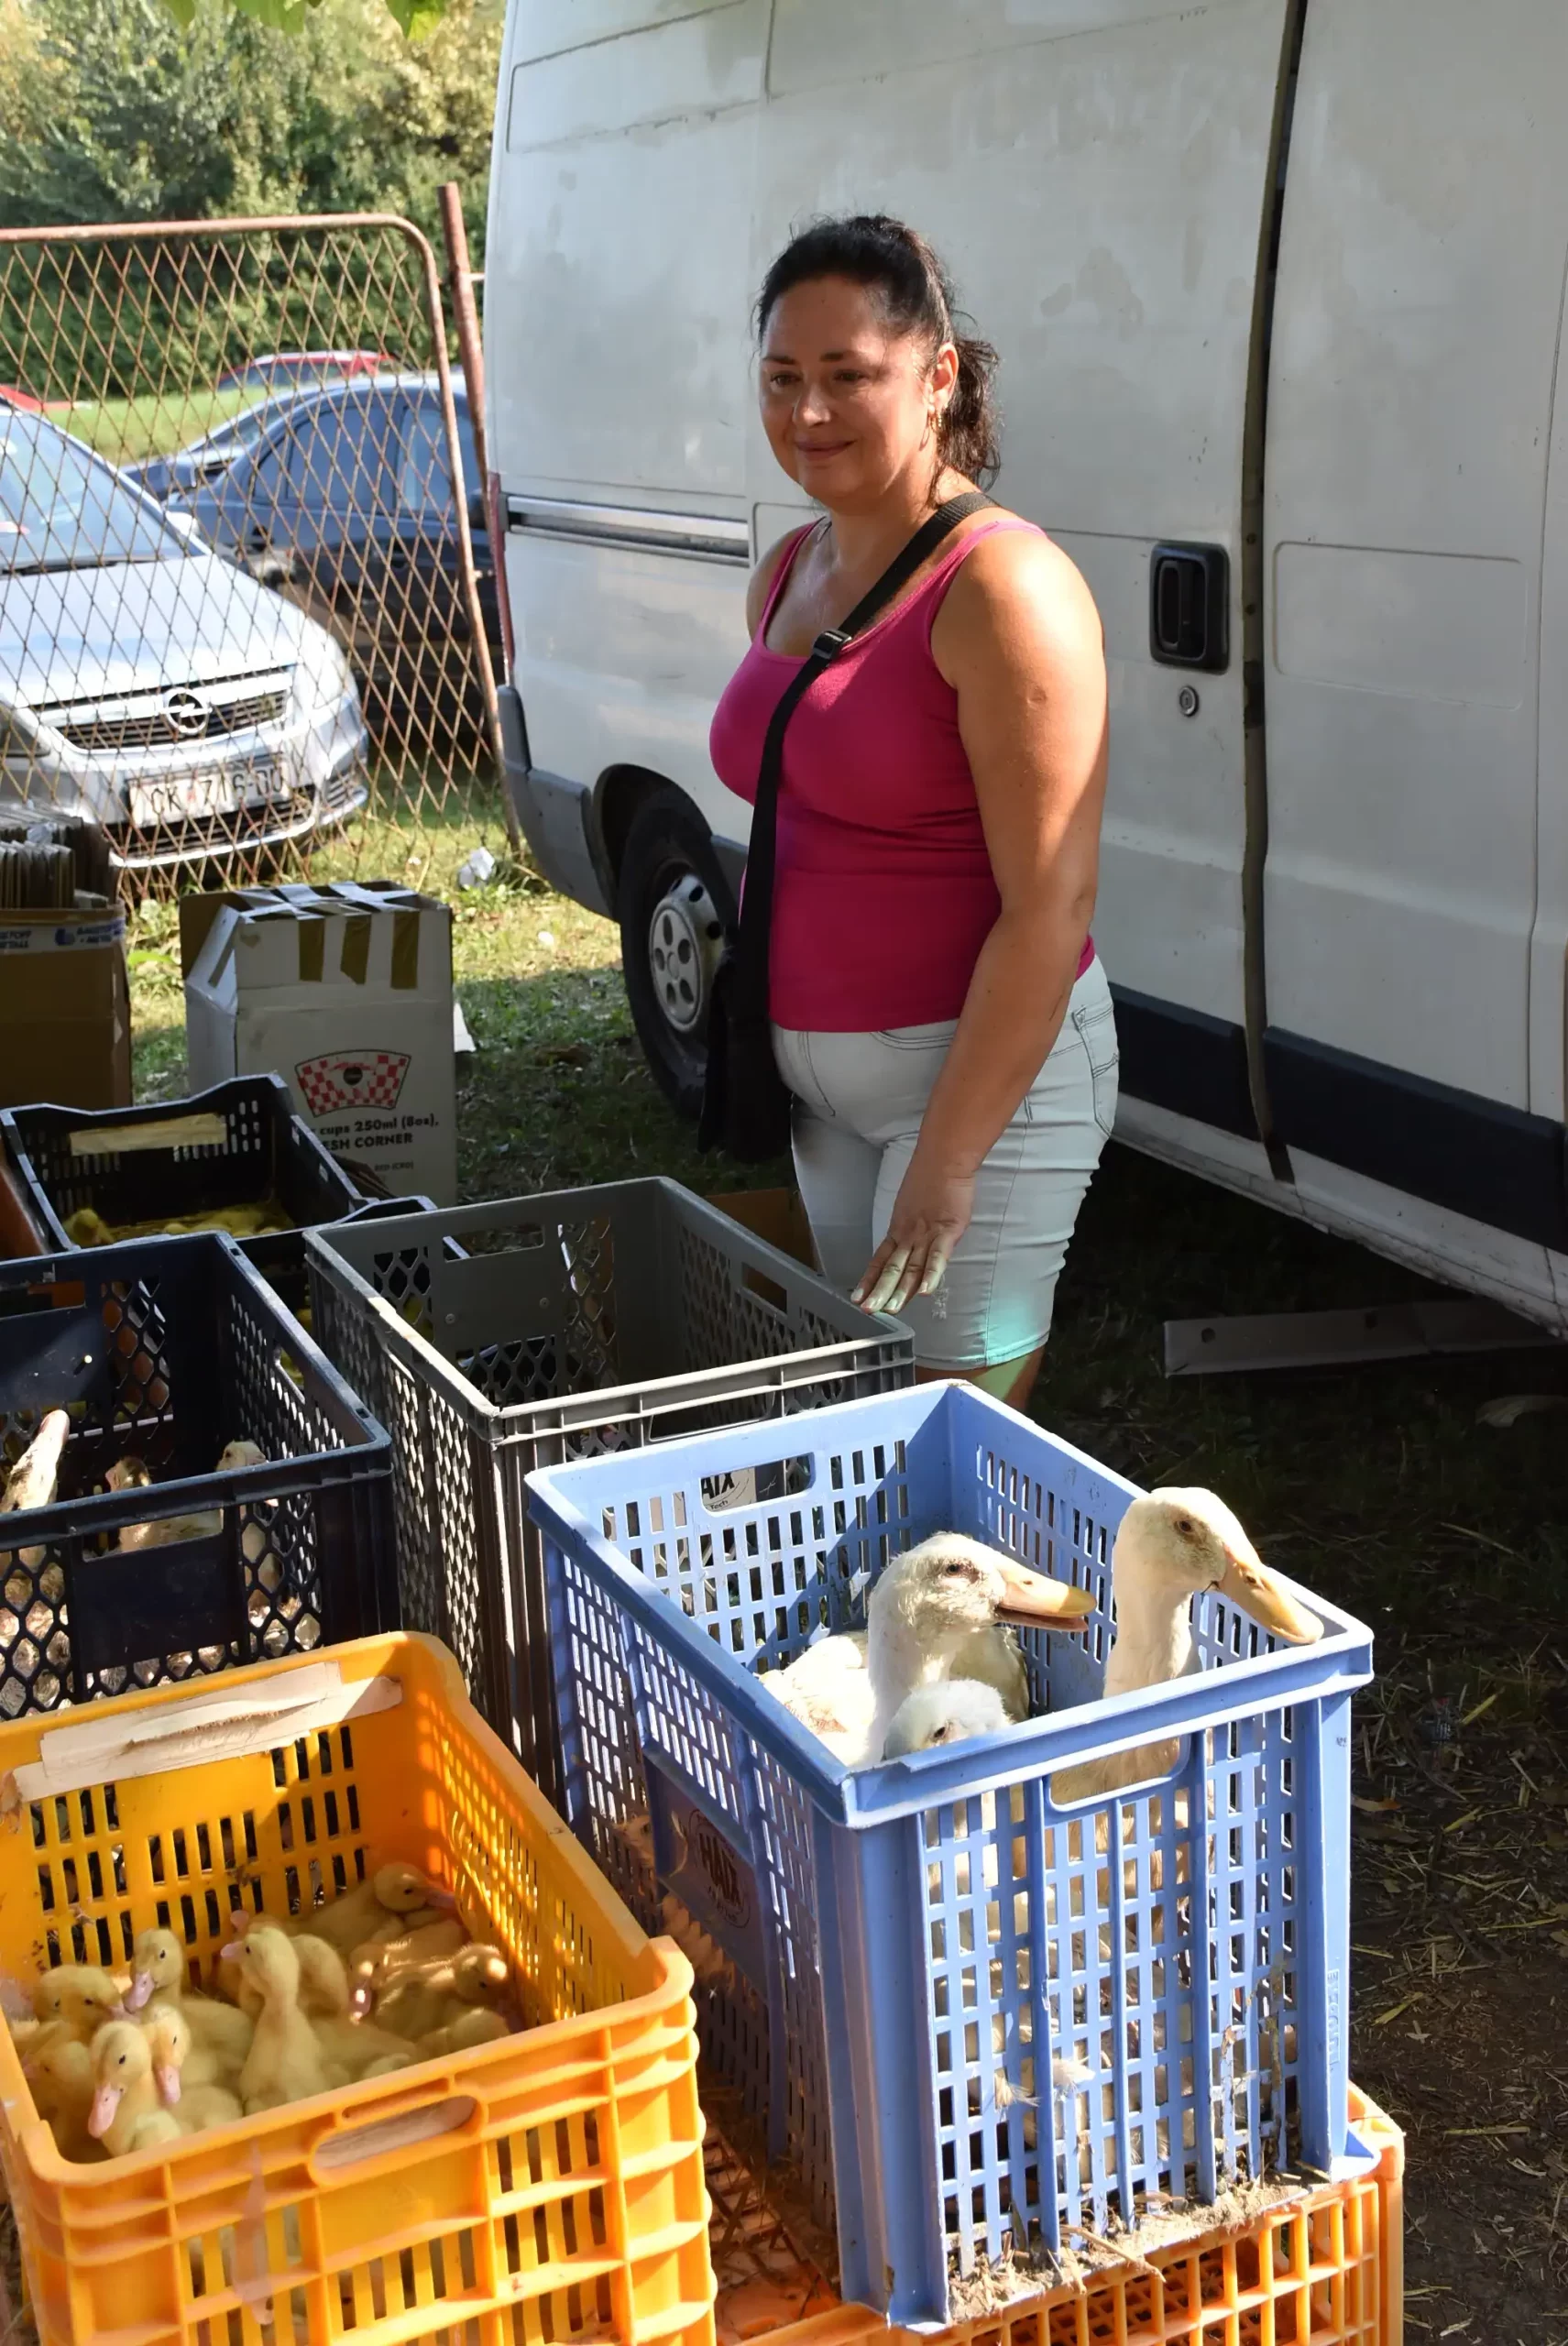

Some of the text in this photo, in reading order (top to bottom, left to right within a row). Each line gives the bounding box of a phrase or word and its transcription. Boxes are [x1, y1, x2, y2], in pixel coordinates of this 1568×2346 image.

[320, 1125, 350, 1136] cups
[355, 1117, 397, 1132] 250ml
[355, 1133, 413, 1148] CORNER
[710, 1500, 729, 1510] Tech
